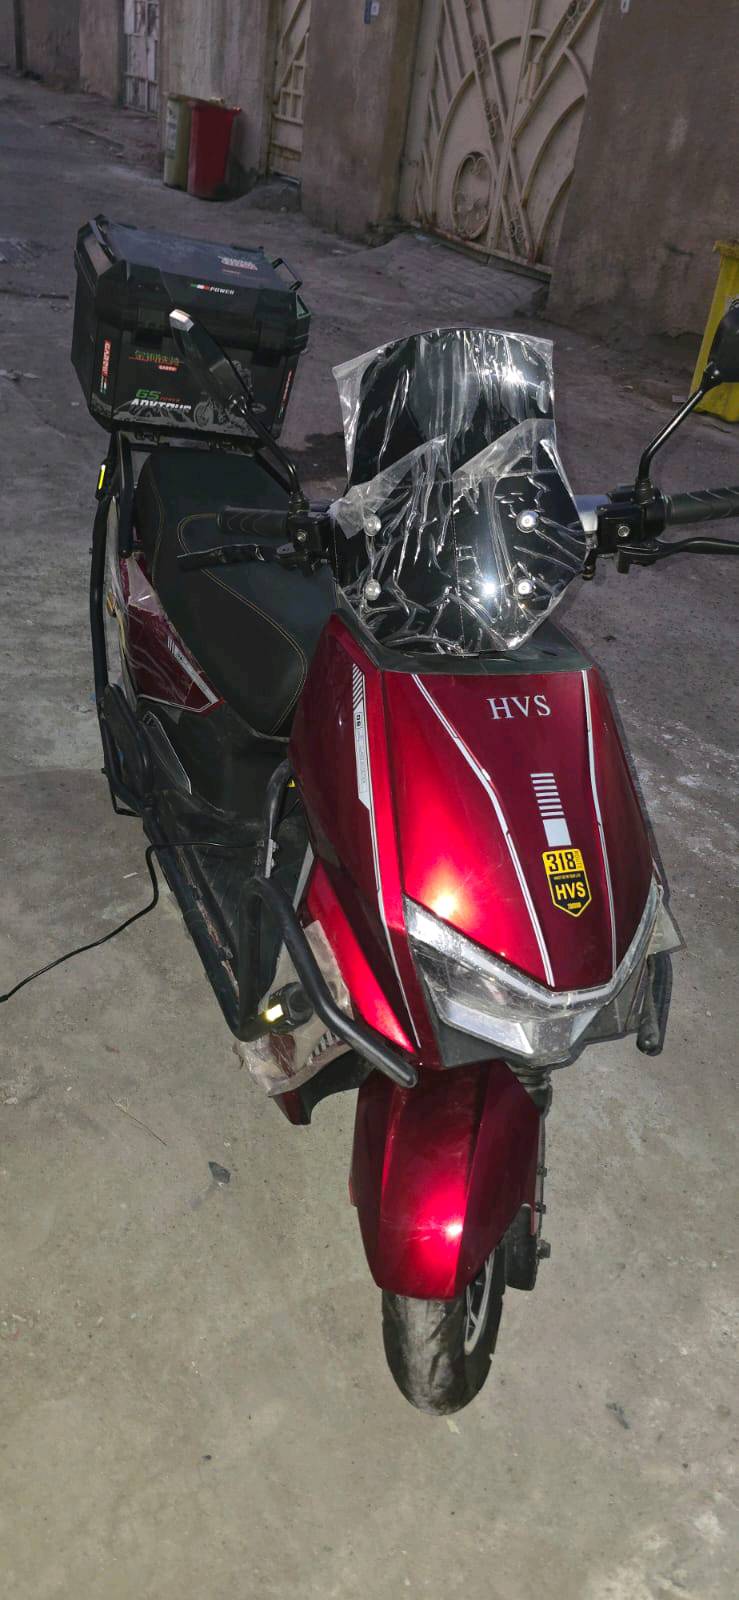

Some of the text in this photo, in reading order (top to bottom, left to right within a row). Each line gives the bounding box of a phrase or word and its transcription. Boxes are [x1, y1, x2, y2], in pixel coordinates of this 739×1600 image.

[209, 286, 235, 295] POWER
[136, 389, 161, 400] GS
[486, 694, 551, 719] HVS
[546, 851, 577, 872] 318
[555, 881, 586, 901] HVS
